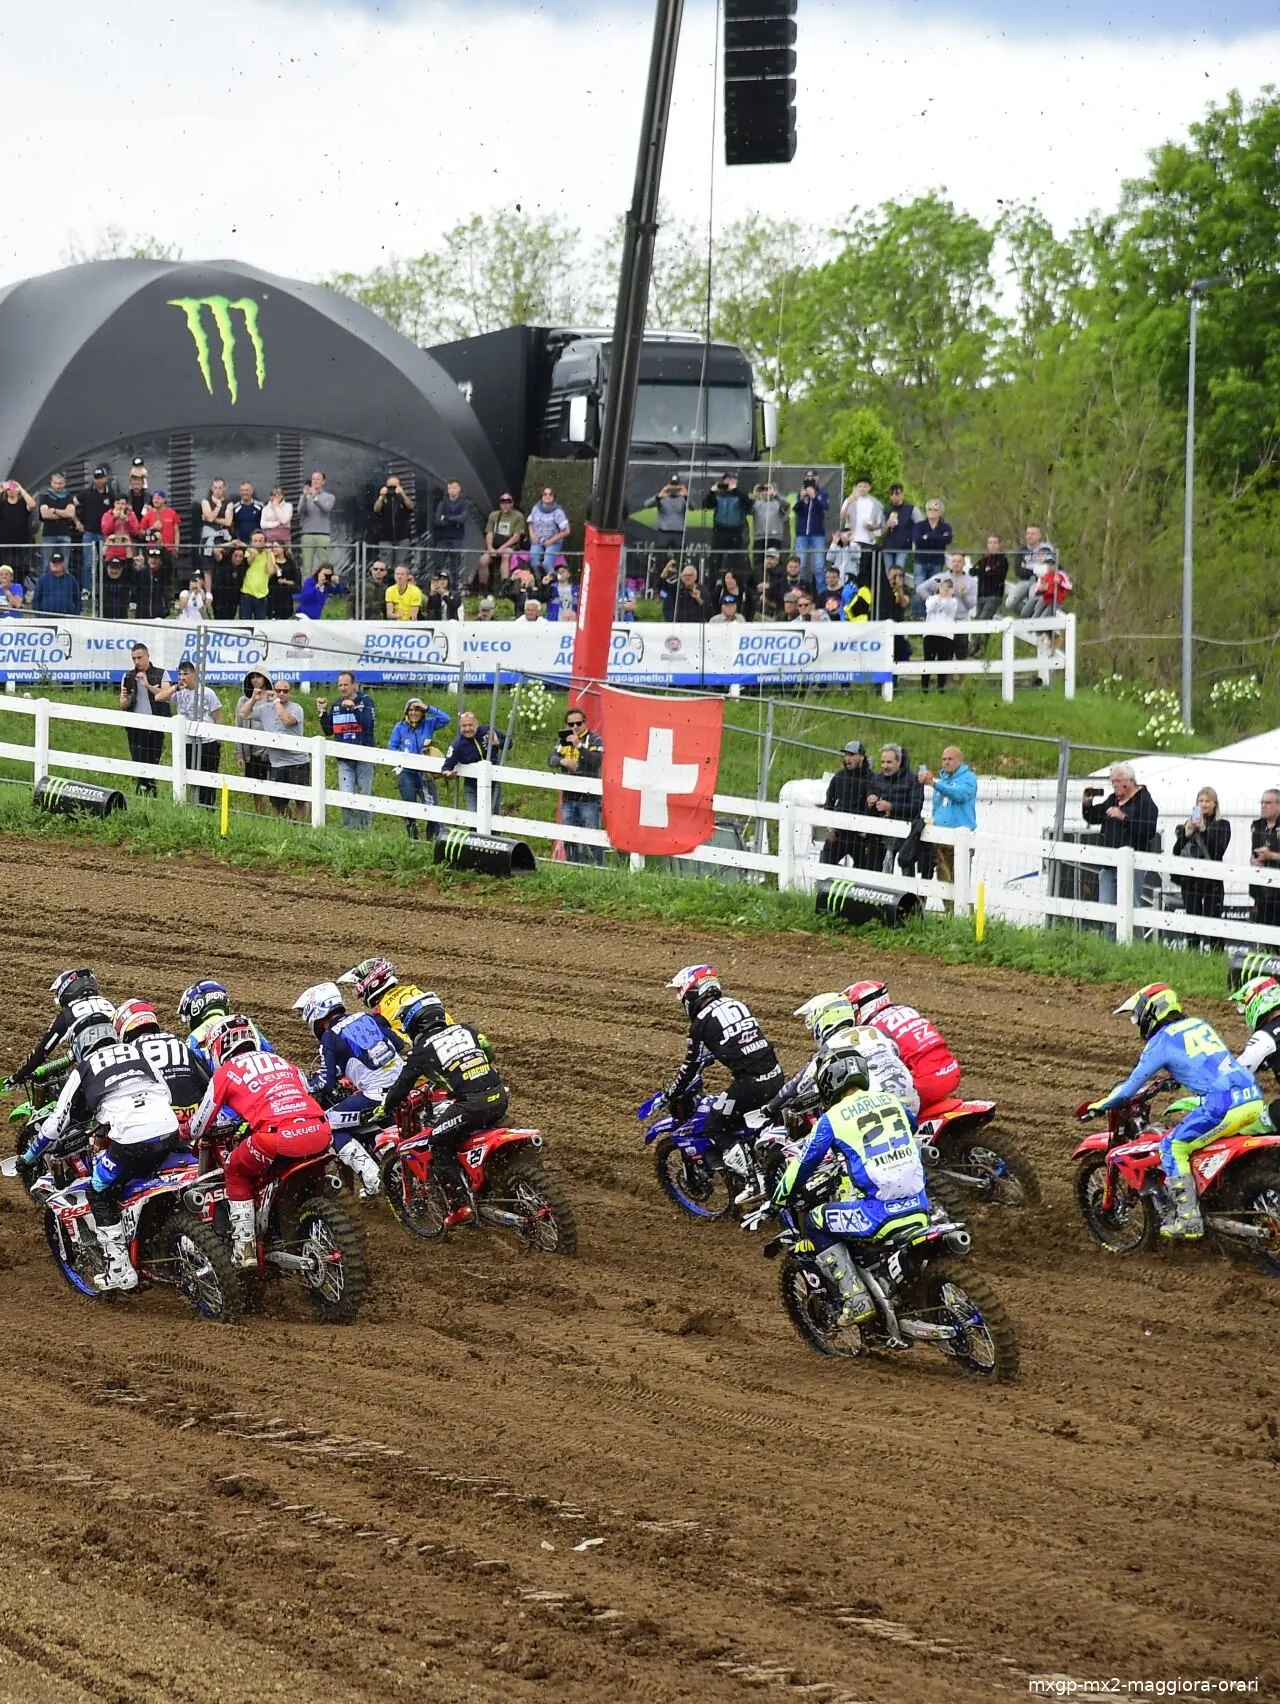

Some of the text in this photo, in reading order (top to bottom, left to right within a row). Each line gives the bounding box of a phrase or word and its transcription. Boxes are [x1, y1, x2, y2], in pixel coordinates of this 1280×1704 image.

[87, 638, 138, 650] IVECO
[364, 634, 431, 649] BORGO
[463, 640, 511, 652] IVECO
[738, 636, 801, 650] BORGO
[831, 640, 881, 652] IVECO
[732, 652, 812, 666] AGNELLO
[382, 672, 487, 682] www.borgoagnllo.it
[711, 1000, 751, 1029] 161
[432, 1028, 476, 1067] 29
[89, 1043, 141, 1077] 89
[235, 1053, 293, 1084] 303
[462, 1063, 491, 1081] CIRCUIT
[273, 1101, 307, 1113] GASGAS
[339, 1113, 359, 1122] TH
[856, 1106, 910, 1159] 23
[470, 1148, 483, 1167] 29
[873, 1147, 913, 1167] JUMBO
